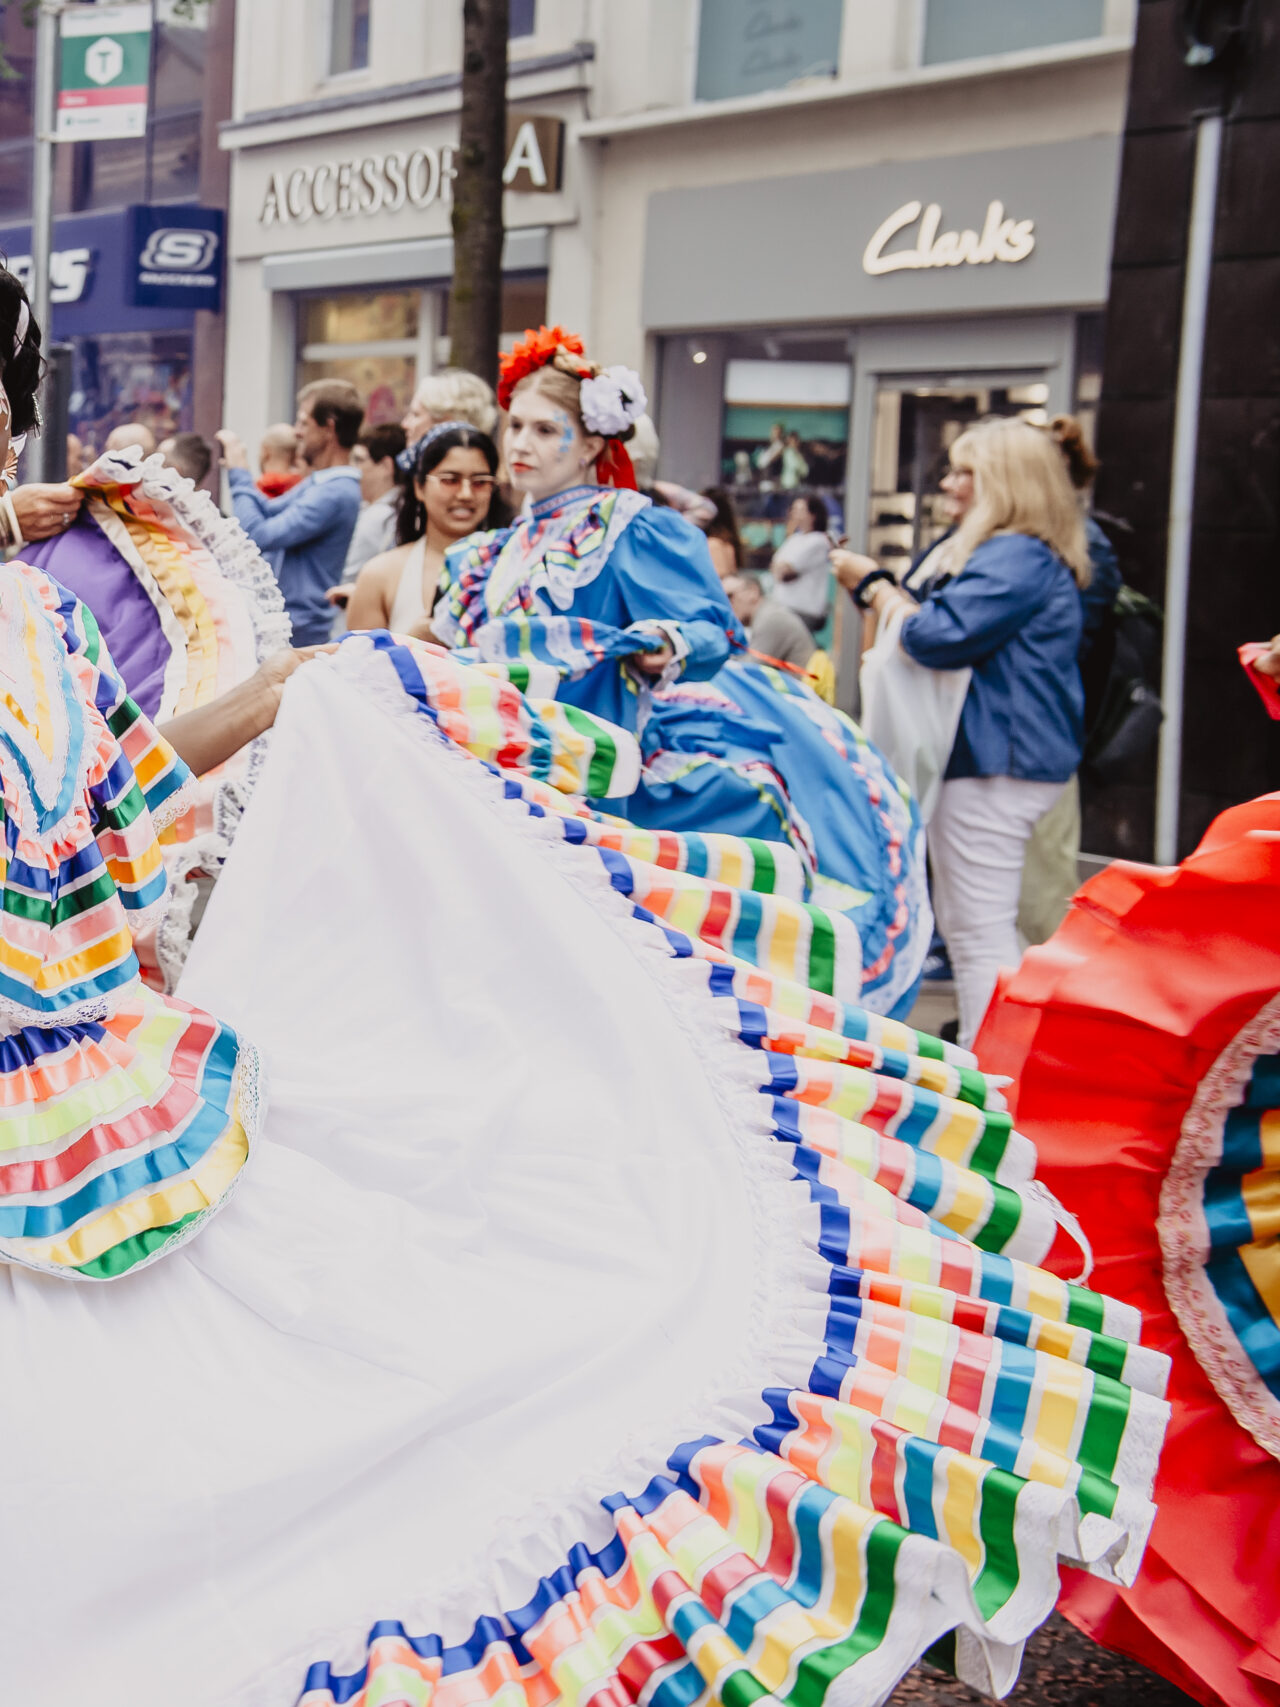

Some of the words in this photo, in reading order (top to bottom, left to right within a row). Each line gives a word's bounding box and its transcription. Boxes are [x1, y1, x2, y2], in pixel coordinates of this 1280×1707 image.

[96, 49, 112, 75] T
[503, 121, 548, 187] A
[862, 200, 1035, 275] Clarks
